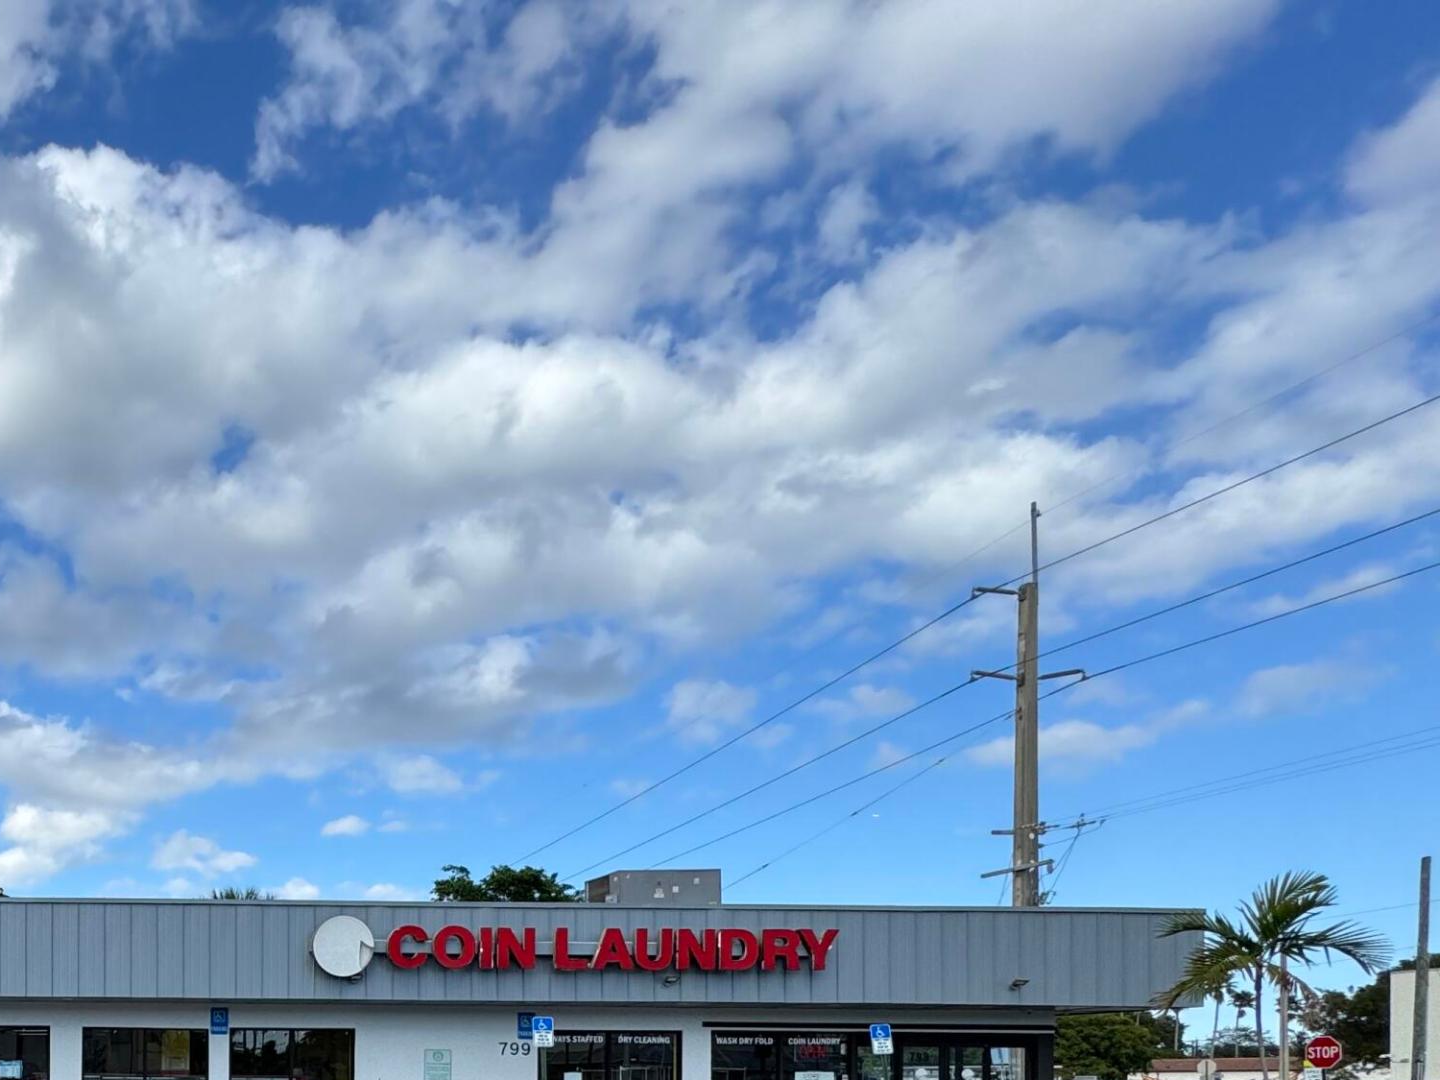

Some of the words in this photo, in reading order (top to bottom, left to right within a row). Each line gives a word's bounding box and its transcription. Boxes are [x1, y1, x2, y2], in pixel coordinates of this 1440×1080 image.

[386, 924, 537, 971] COIN
[553, 926, 840, 973] LAUNDRY
[552, 1035, 571, 1043] WAYS
[572, 1035, 604, 1043] STAFFED
[634, 1036, 671, 1044] CLEANING
[716, 1037, 738, 1045] WASH
[739, 1037, 753, 1045] DRY
[755, 1037, 774, 1045] FOLD
[788, 1037, 806, 1045] COIN
[807, 1037, 840, 1045] LAUNDRY
[499, 1042, 531, 1056] 799
[1307, 1046, 1339, 1059] STOP
